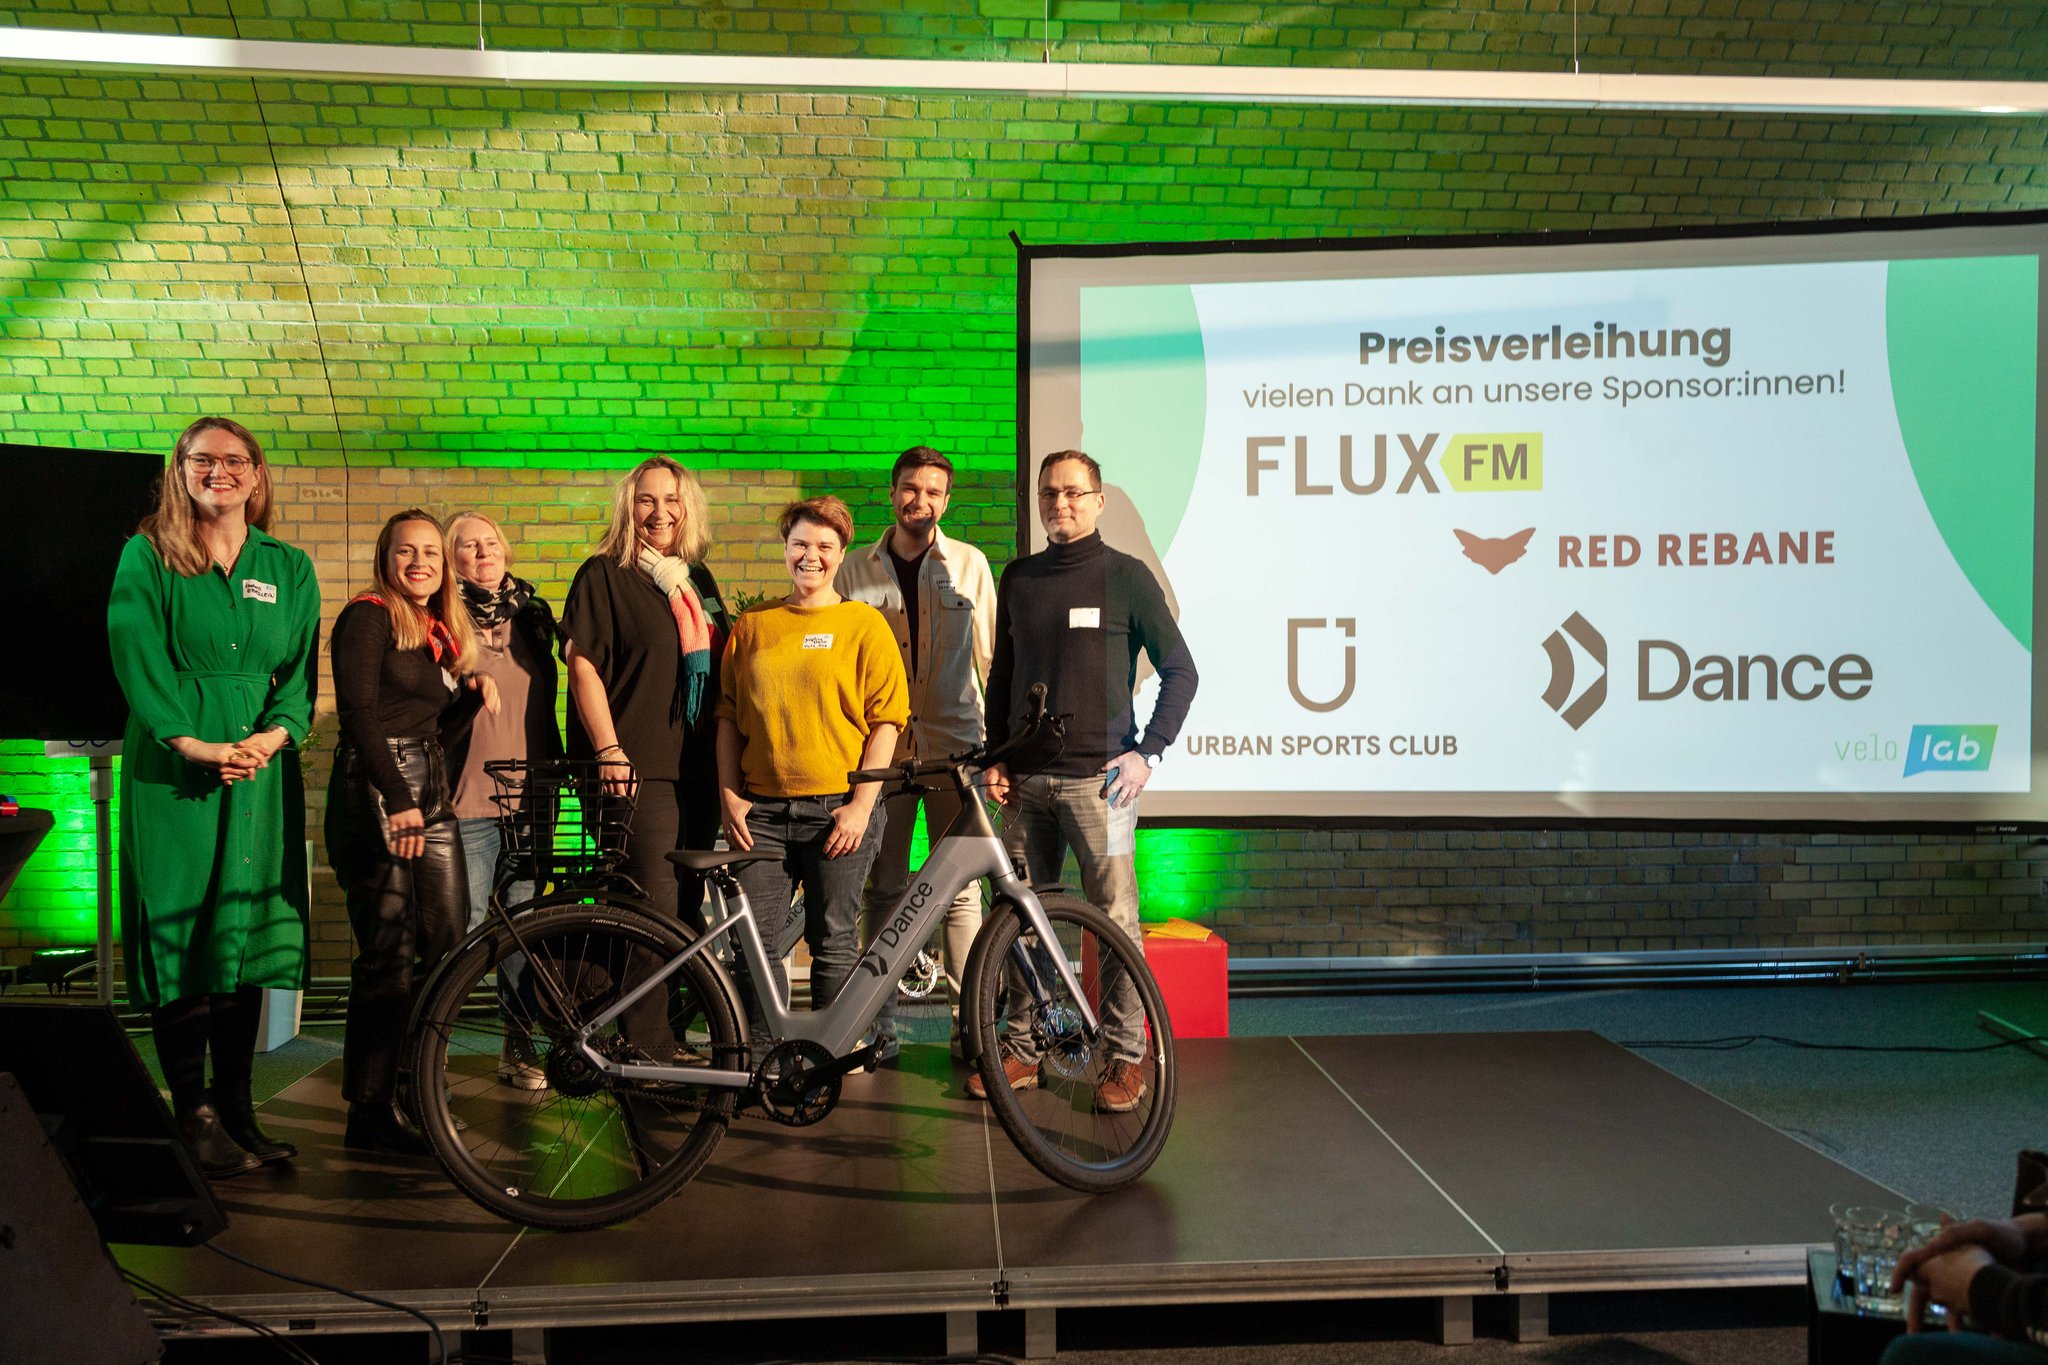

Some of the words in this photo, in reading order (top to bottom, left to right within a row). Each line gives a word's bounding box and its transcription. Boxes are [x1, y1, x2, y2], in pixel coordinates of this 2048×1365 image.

[1359, 321, 1732, 368] Preisverleihung
[1242, 383, 1334, 408] vielen
[1344, 381, 1423, 407] Dank
[1432, 385, 1473, 405] an
[1484, 378, 1593, 403] unsere
[1603, 369, 1846, 408] Sponsor:innen!
[1246, 432, 1441, 497] FLUX
[1463, 443, 1528, 482] FM
[1558, 534, 1642, 568] RED
[1658, 530, 1836, 567] REBANE
[1637, 639, 1874, 702] Dance
[1187, 735, 1273, 757] URBAN
[1281, 735, 1381, 757] SPORTS
[1389, 735, 1458, 757] CLUB
[1834, 732, 1898, 762] velo
[1920, 733, 1981, 763] lab
[879, 882, 933, 949] Dance
